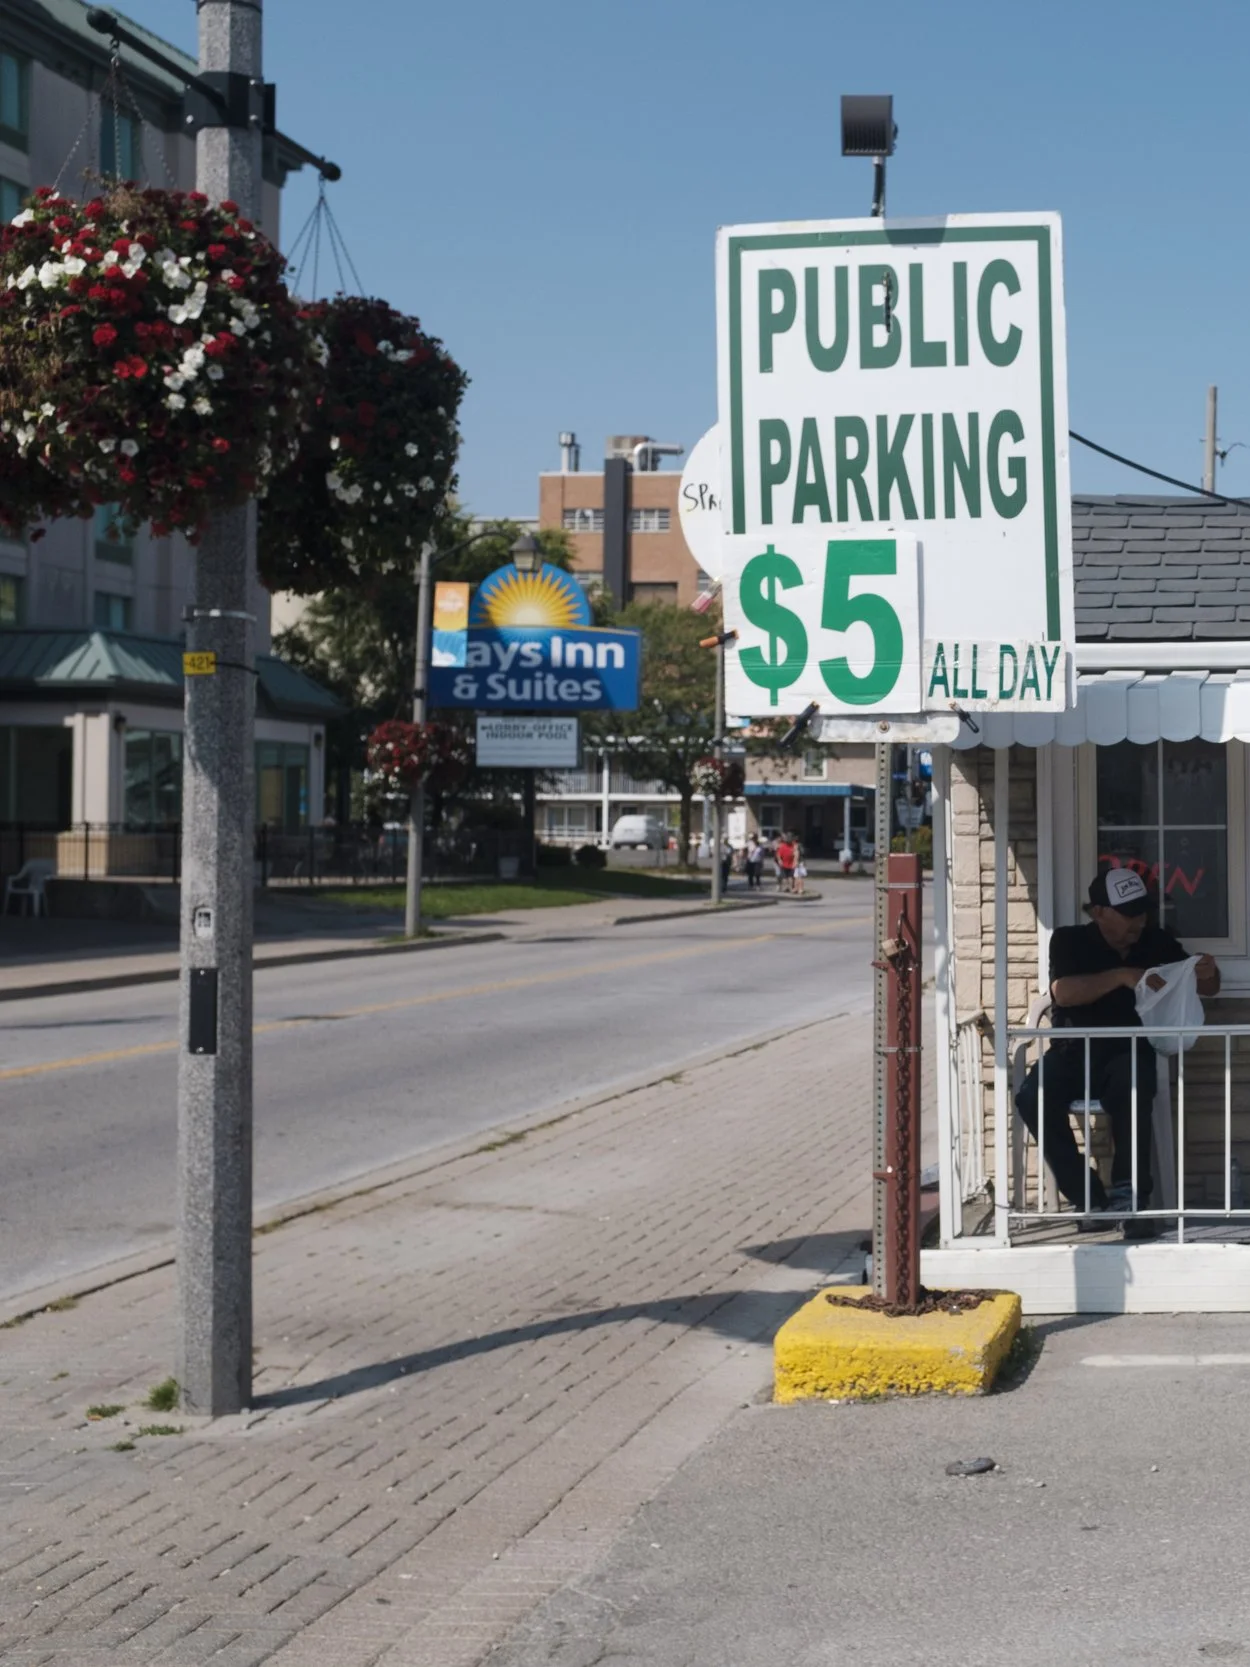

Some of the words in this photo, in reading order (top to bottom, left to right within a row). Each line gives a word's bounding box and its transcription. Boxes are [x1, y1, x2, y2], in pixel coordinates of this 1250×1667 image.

[758, 258, 1023, 373] PUBLIC
[758, 408, 1028, 525] PARKING
[467, 641, 543, 671] ays
[551, 636, 625, 668] Inn
[737, 538, 904, 706] $5
[453, 673, 479, 700] &
[486, 672, 602, 702] Suites
[928, 642, 987, 699] ALL
[998, 644, 1061, 701] DAY
